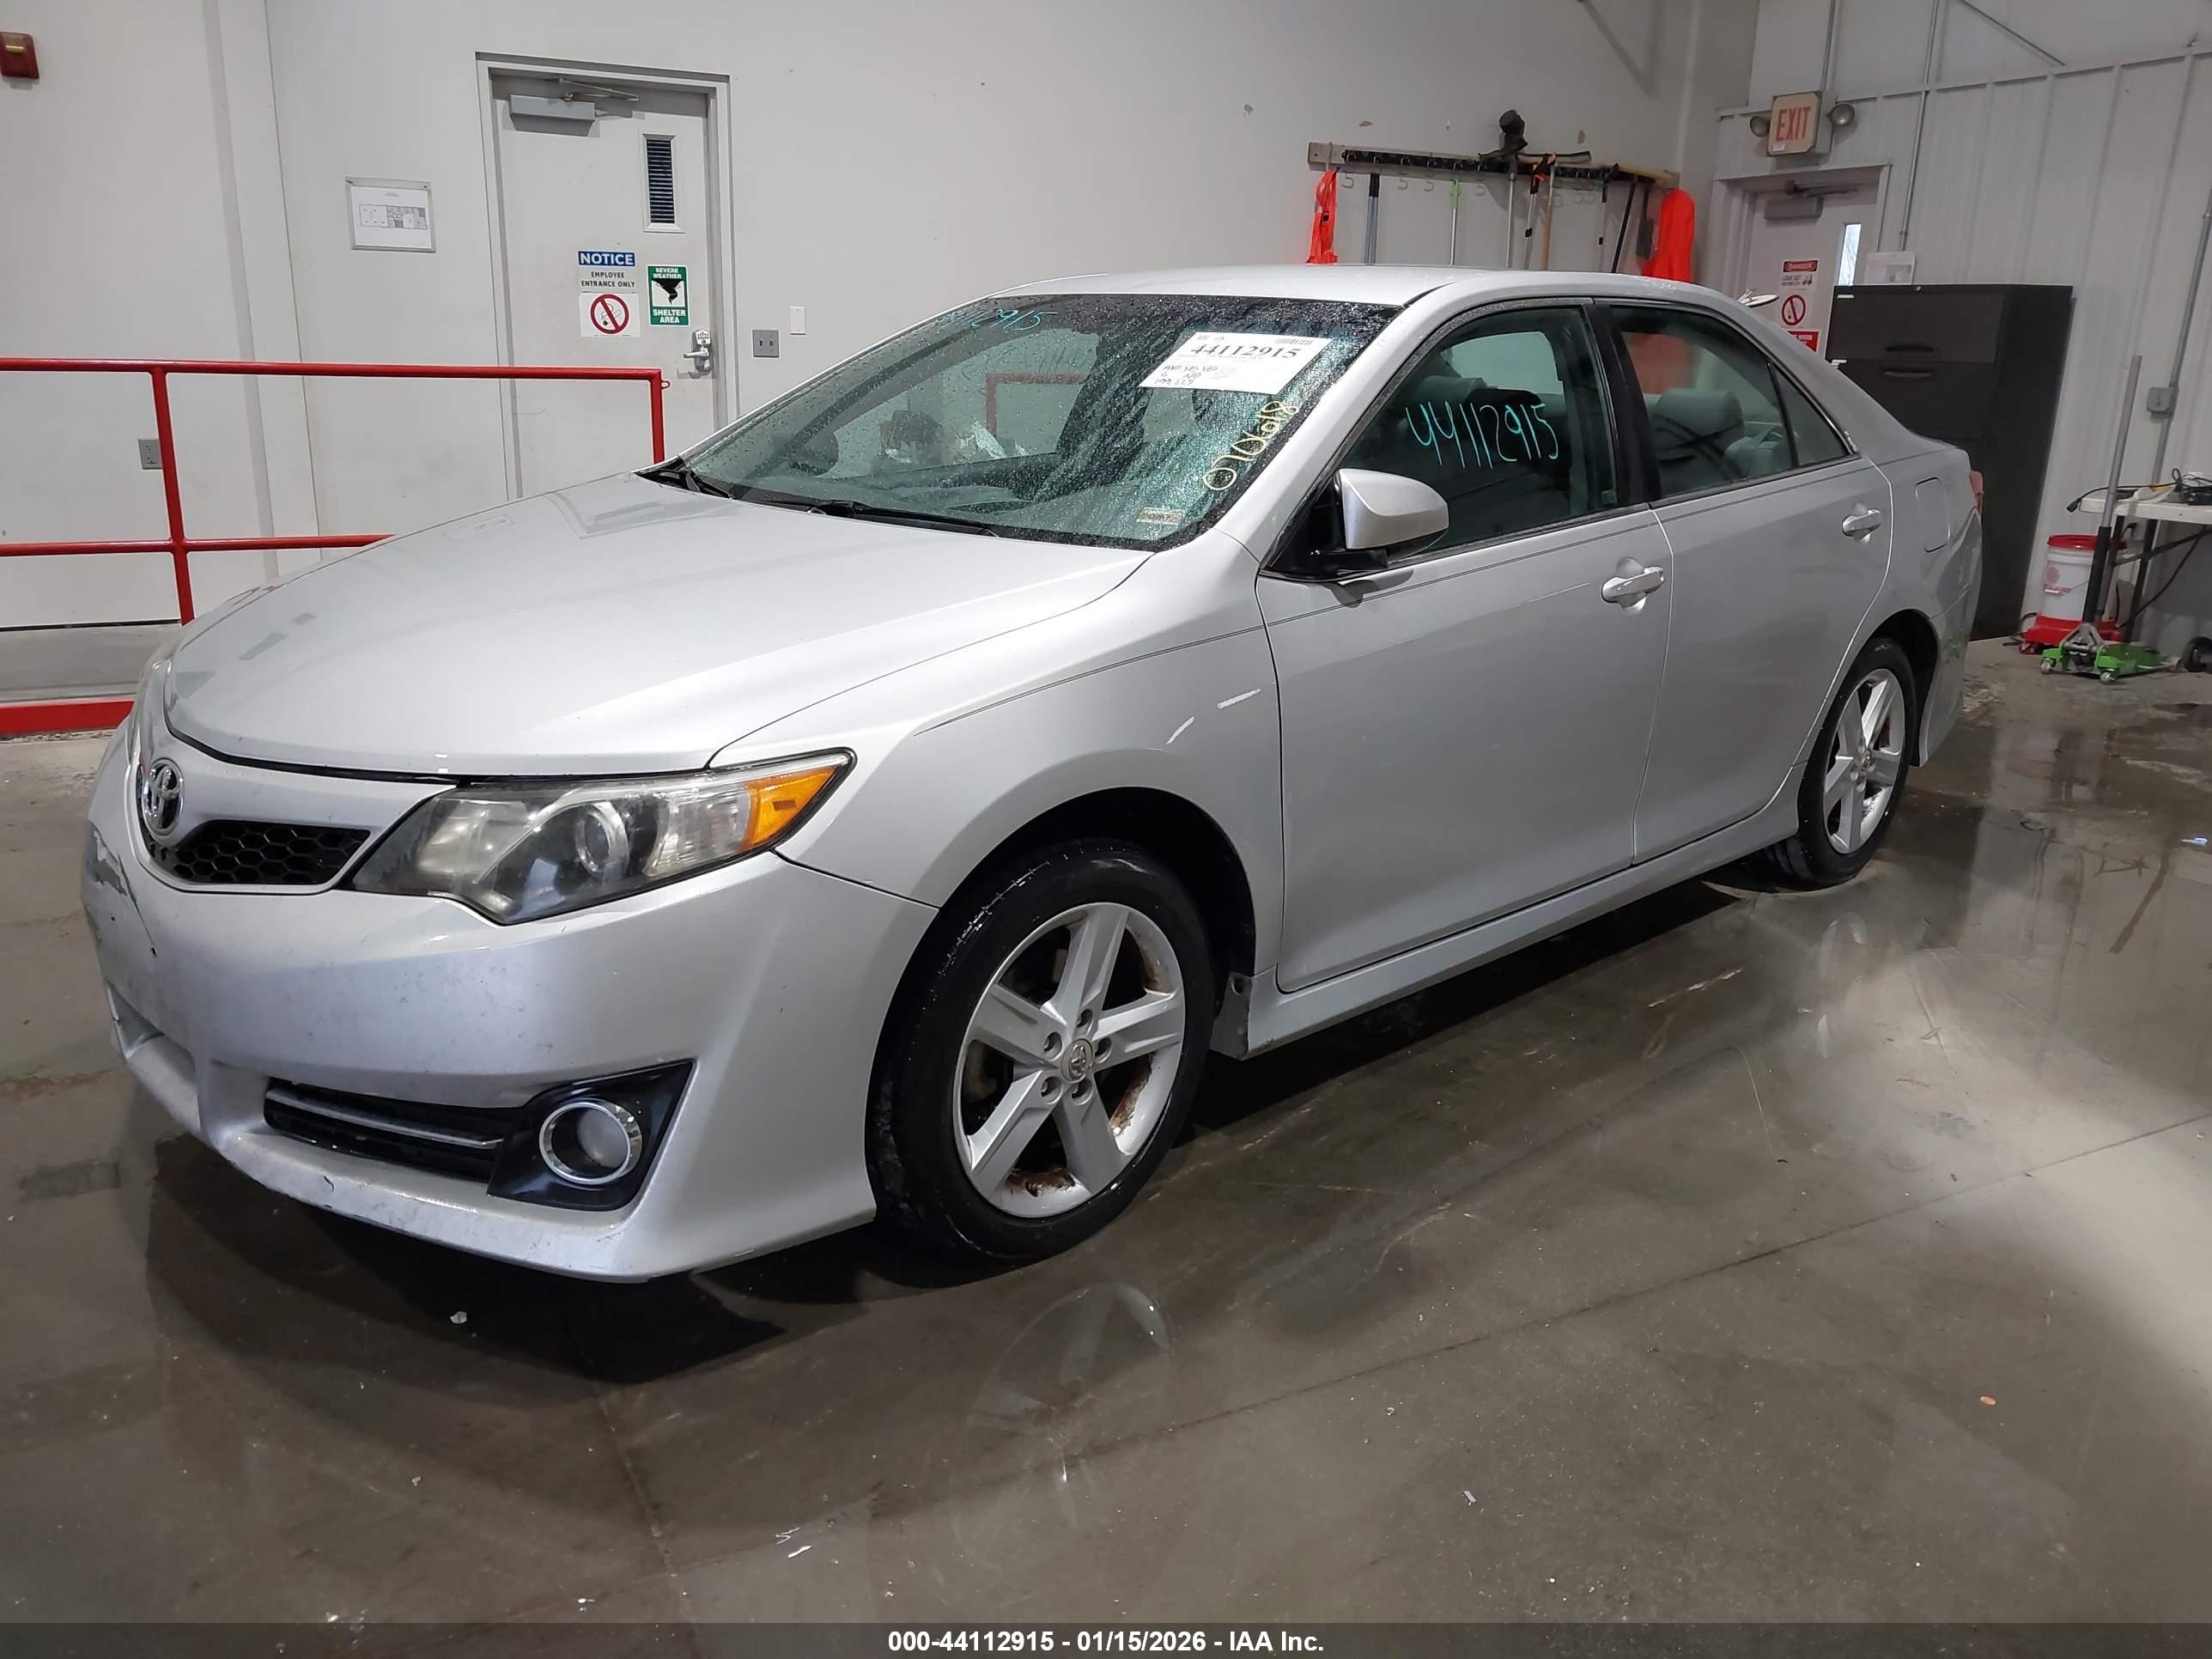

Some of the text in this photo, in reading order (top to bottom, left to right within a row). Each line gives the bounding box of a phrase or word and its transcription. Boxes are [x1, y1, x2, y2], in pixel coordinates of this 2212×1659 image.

[1775, 106, 1812, 142] EXIT
[580, 252, 635, 265] NOTICE
[653, 308, 686, 317] SHELTER
[1190, 343, 1303, 359] 44112915
[1405, 399, 1559, 471] 44112915
